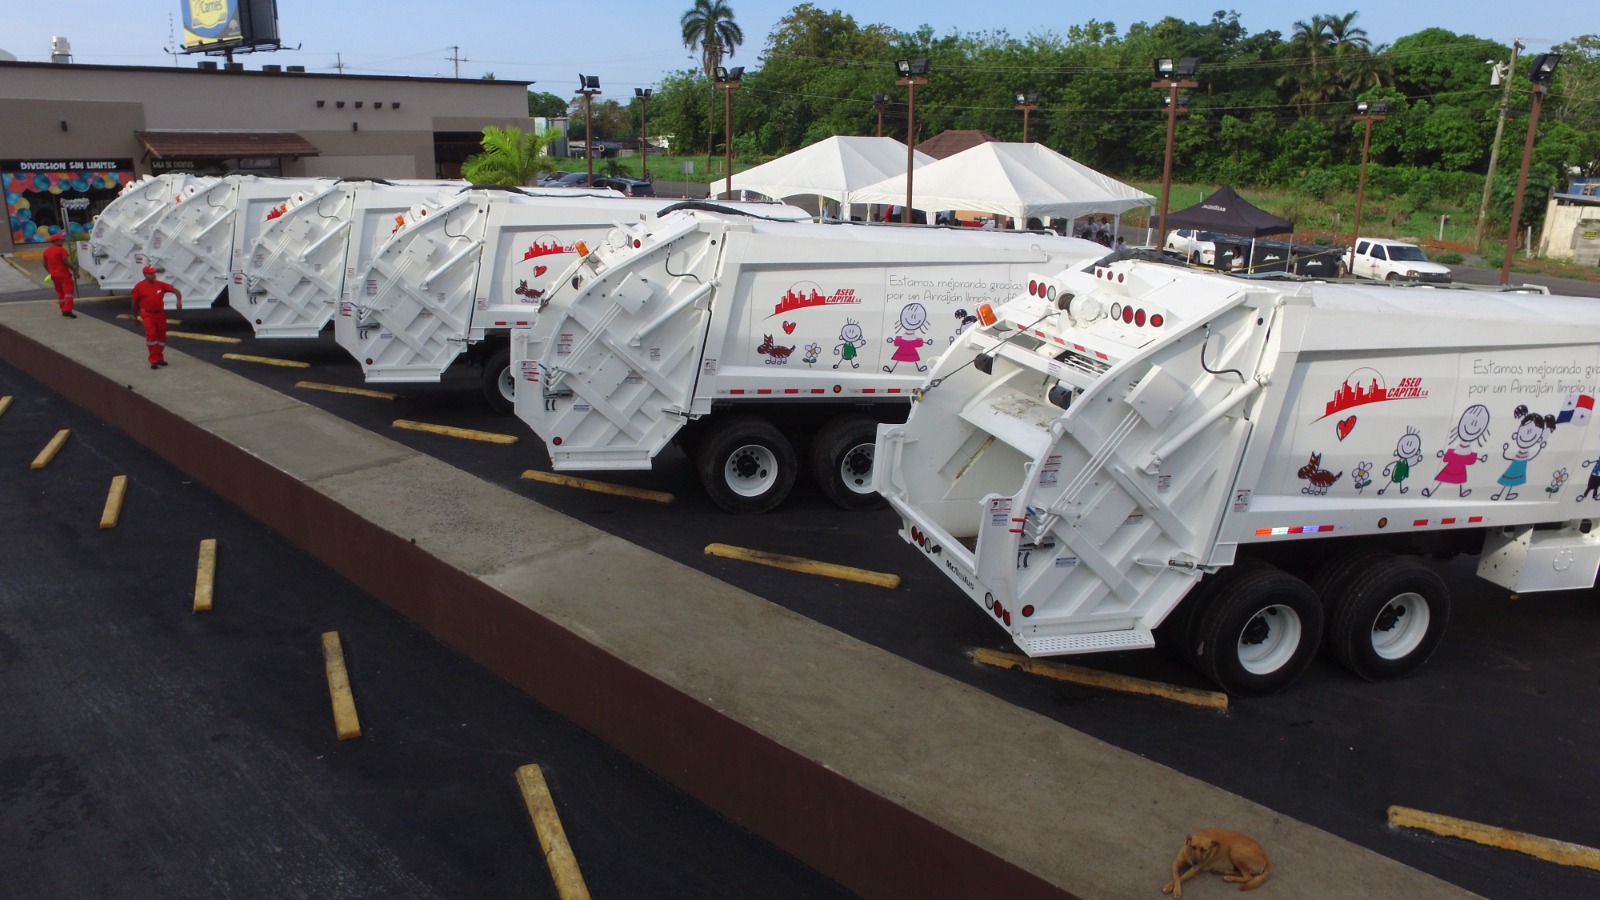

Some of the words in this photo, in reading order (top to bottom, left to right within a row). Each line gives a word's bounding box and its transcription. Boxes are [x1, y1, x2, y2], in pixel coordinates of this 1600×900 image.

[20, 162, 66, 170] DIVERSION
[69, 161, 84, 169] SIN
[86, 161, 117, 169] LIMITES
[889, 275, 934, 287] Estamos
[938, 277, 987, 291] mejorando
[990, 279, 1023, 292] gracias
[826, 295, 855, 303] CAPITAL
[886, 292, 904, 303] por
[1473, 359, 1523, 374] Estamos
[1527, 360, 1582, 379] mejorando
[1399, 378, 1422, 387] ASEO
[1387, 387, 1422, 398] CAPITAL
[1468, 384, 1489, 398] por
[1493, 385, 1506, 393] un
[1557, 379, 1586, 398] limpio
[1588, 384, 1596, 398] y
